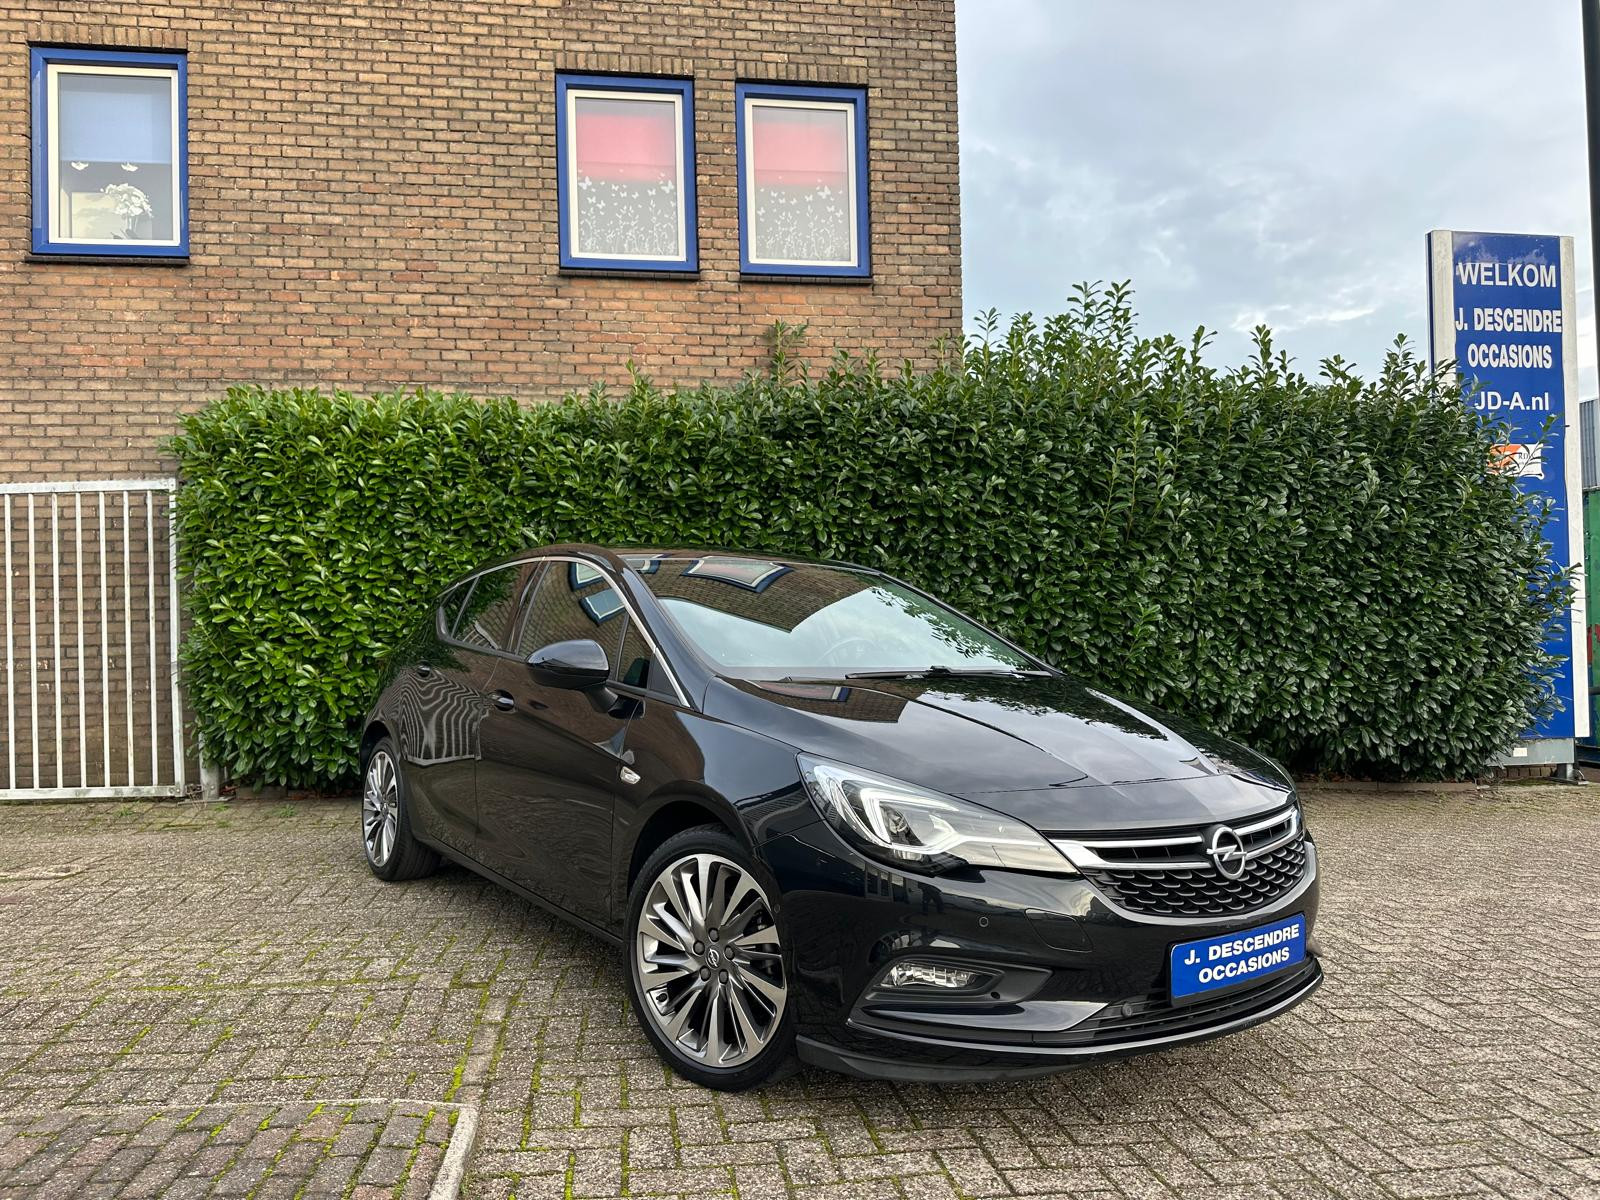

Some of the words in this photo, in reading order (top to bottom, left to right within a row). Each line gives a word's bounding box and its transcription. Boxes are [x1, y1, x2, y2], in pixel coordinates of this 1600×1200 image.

[1457, 262, 1556, 287] WELKOM
[1456, 307, 1468, 331] J.
[1473, 307, 1562, 333] DESCENDRE
[1467, 343, 1552, 369] OCCASIONS
[1475, 391, 1549, 411] JD-A.nl
[1184, 949, 1201, 965] J.
[1208, 923, 1300, 960] DESCENDRE
[1198, 946, 1290, 983] OCCASIONS
